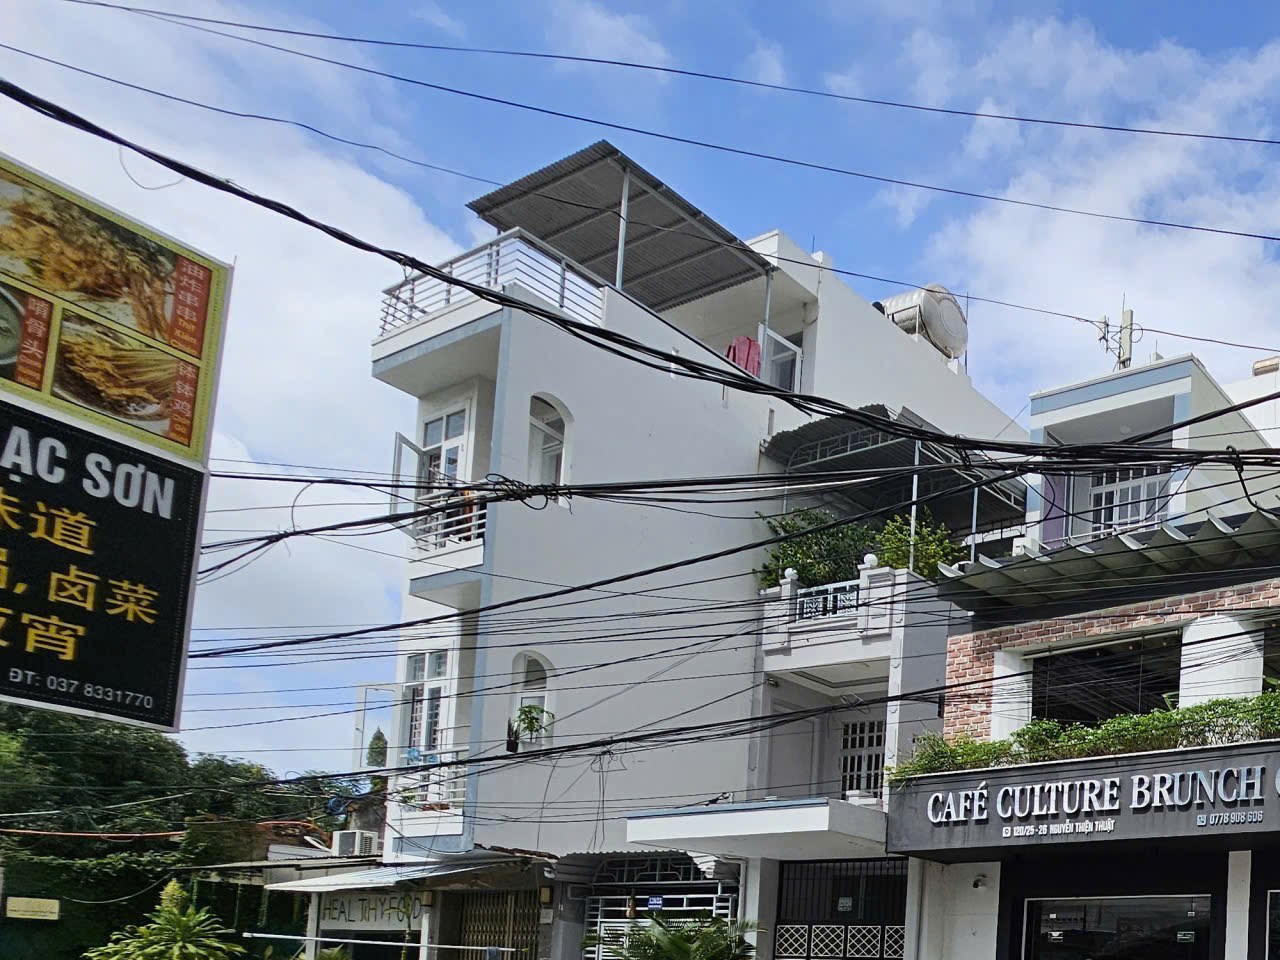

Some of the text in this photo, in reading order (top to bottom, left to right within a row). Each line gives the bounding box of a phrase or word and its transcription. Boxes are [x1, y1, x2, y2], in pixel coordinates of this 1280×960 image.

[82, 452, 175, 520] SƠN
[0, 606, 87, 661] 宵
[9, 667, 153, 709] ĐT: 037 8331770
[927, 780, 988, 824] CAFÉ
[996, 776, 1120, 819] CULTURE
[1129, 765, 1266, 809] BRUNCH
[1209, 812, 1229, 826] 0778
